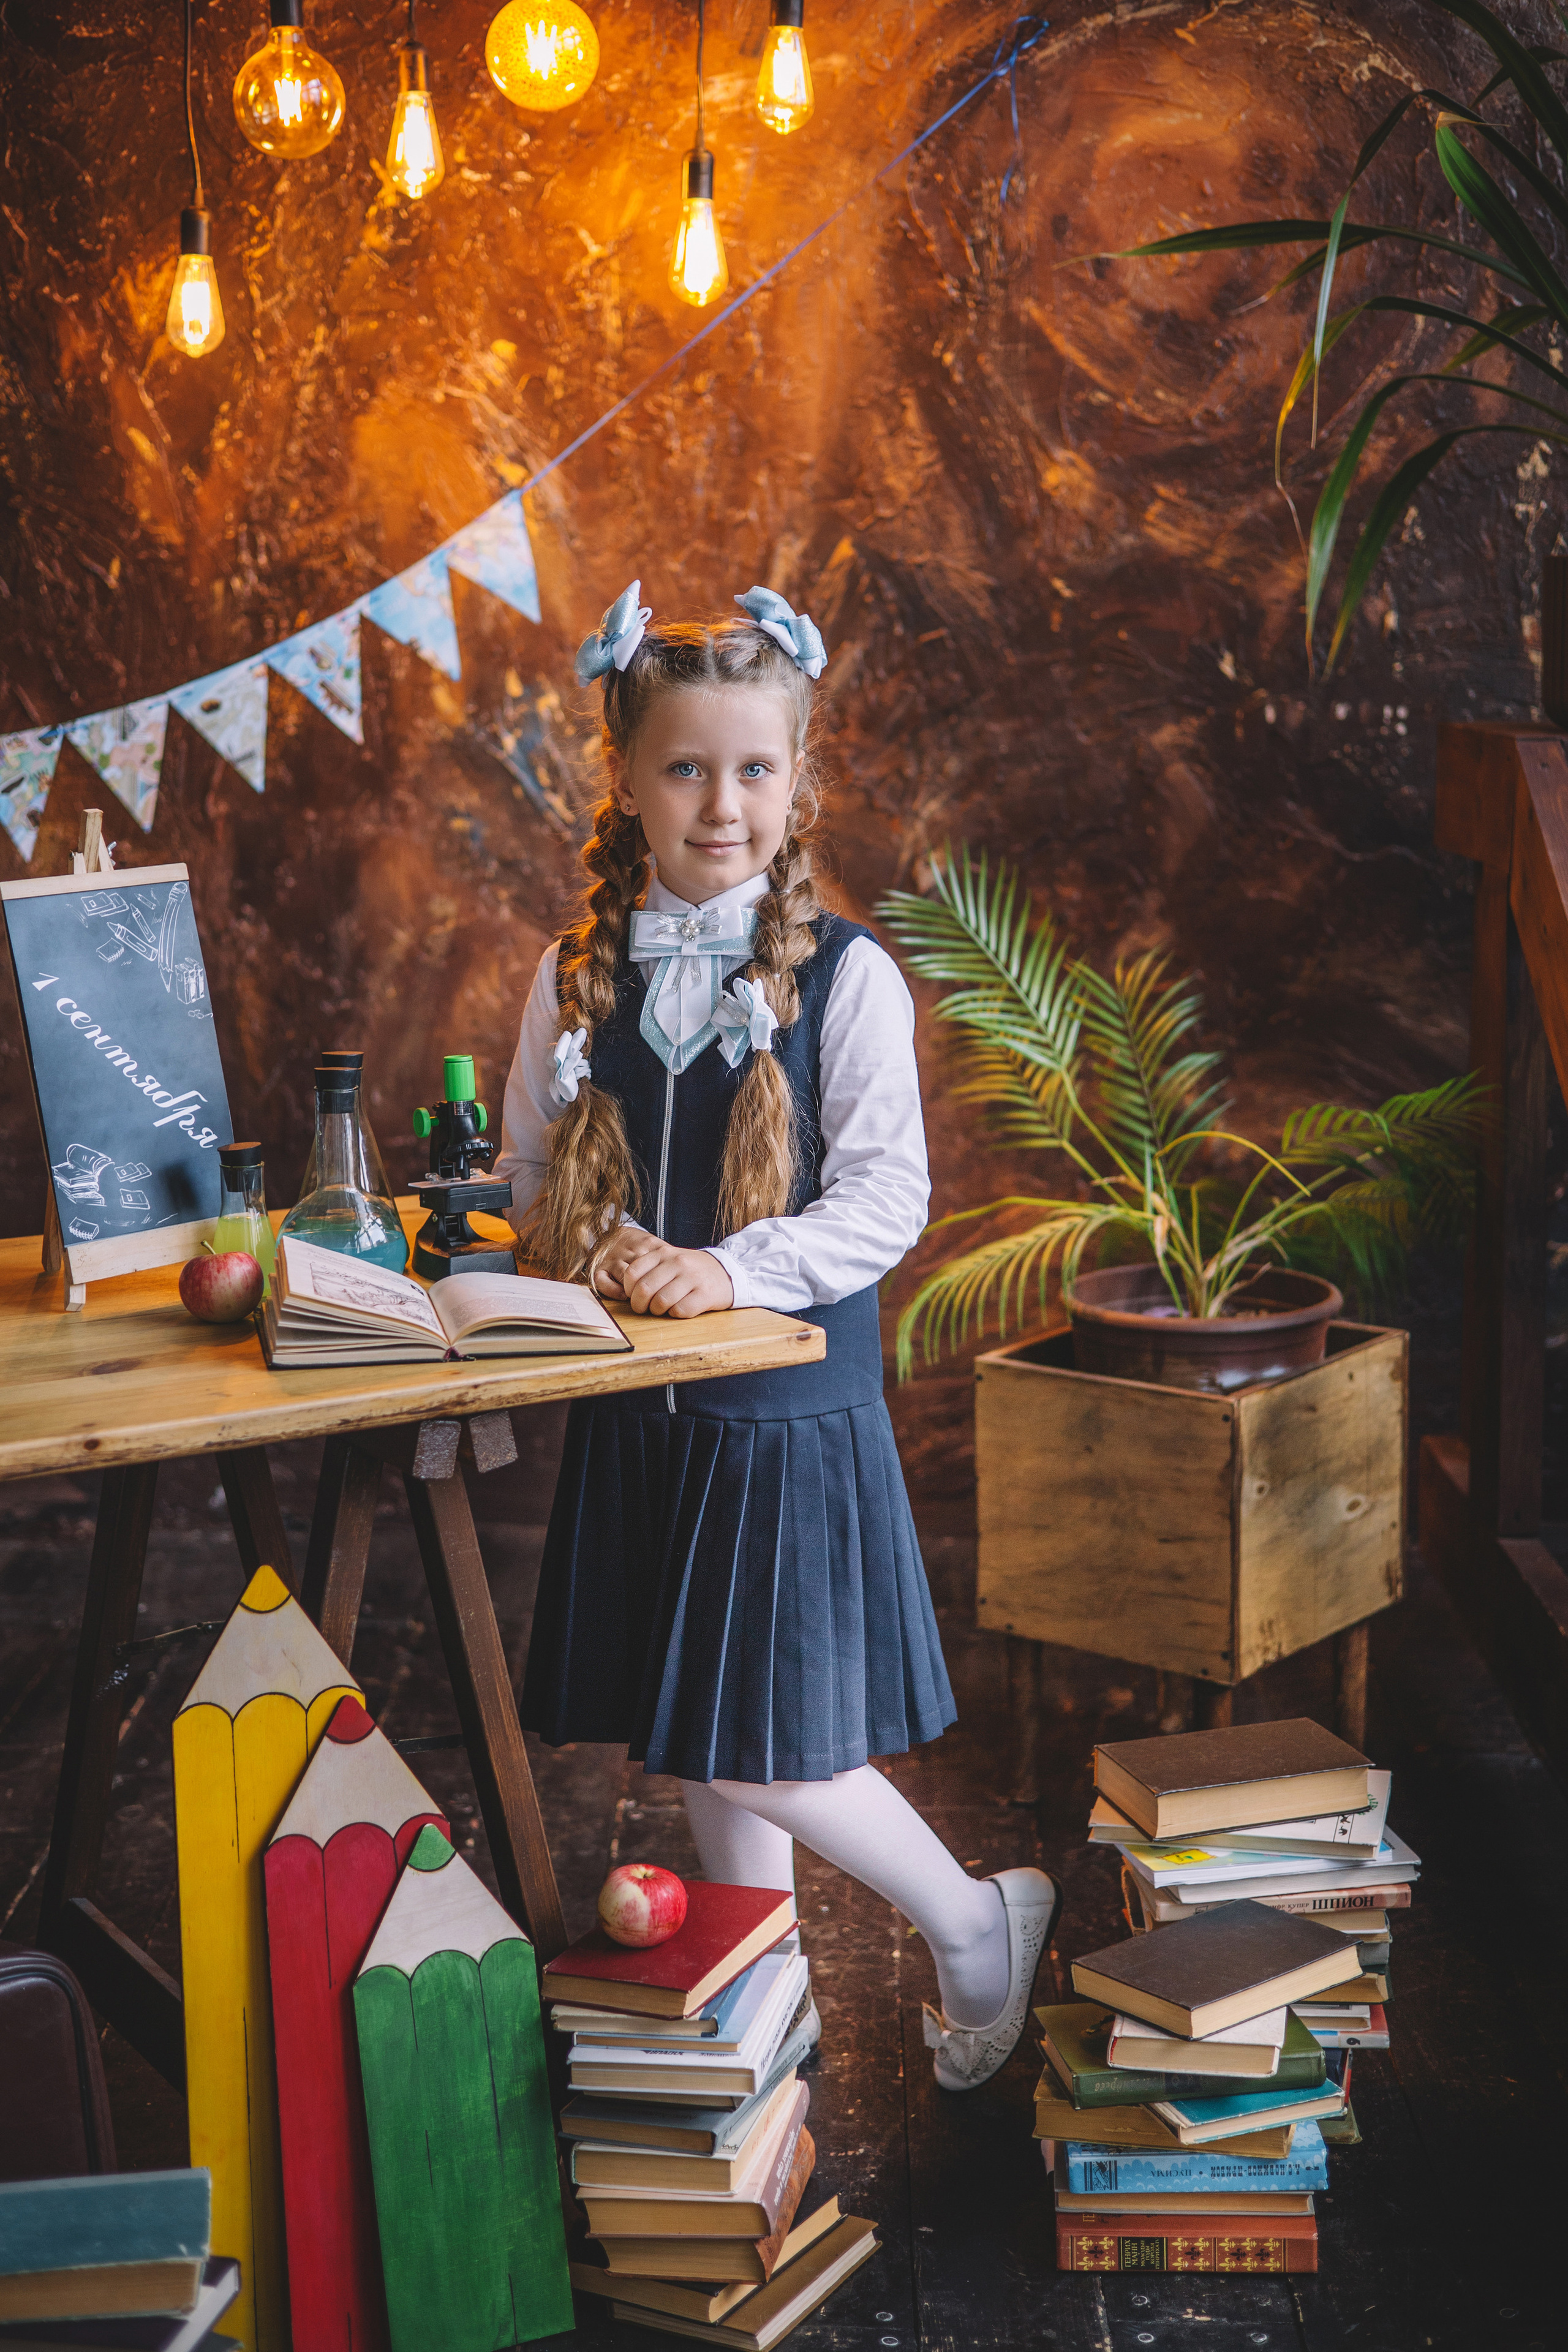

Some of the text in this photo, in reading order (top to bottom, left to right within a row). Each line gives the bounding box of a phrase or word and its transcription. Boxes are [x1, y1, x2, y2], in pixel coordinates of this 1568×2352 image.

[32, 972, 218, 1148] 1 сентября
[1287, 1902, 1310, 1911] КУПЕР
[1312, 1896, 1375, 1910] ШПИОН
[1151, 2169, 1191, 2177] ЦУСИМА
